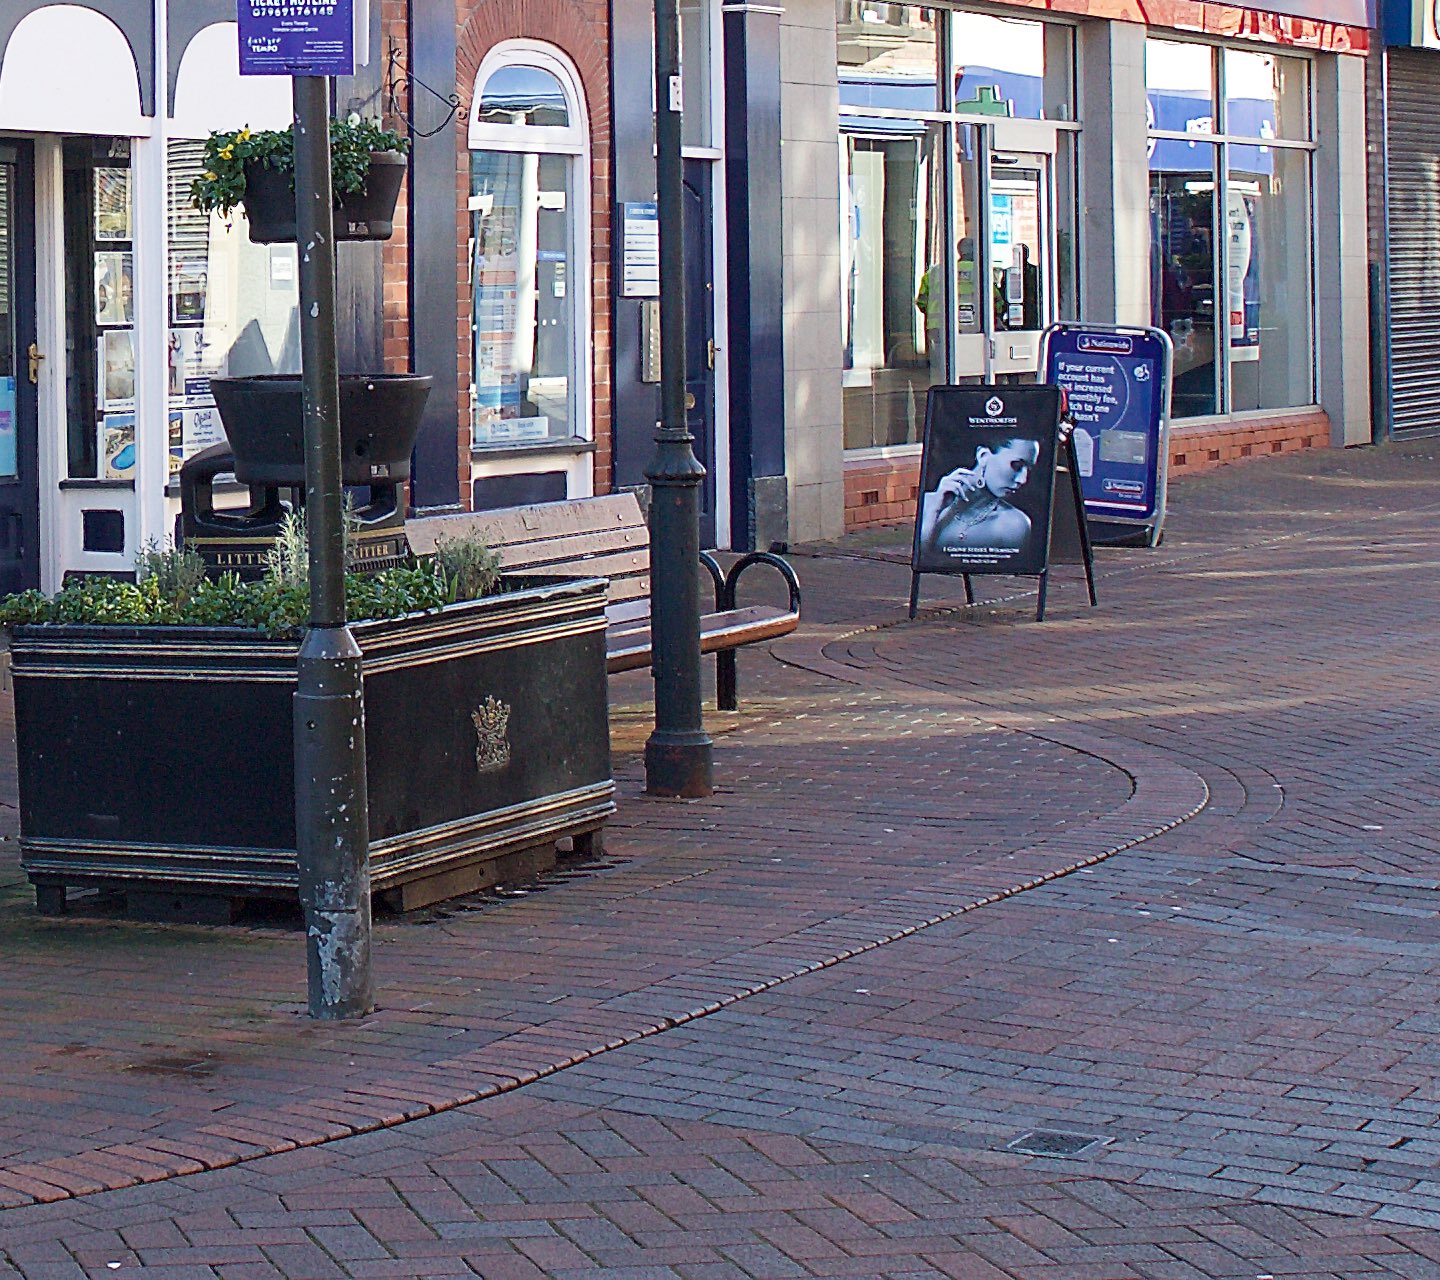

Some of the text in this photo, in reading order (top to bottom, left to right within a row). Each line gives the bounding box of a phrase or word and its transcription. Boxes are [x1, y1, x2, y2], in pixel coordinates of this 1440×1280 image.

[1090, 339, 1130, 349] Nationwide
[1065, 365, 1084, 373] your
[1085, 366, 1115, 374] current
[1058, 374, 1105, 383] account has
[1074, 385, 1113, 393] increased
[1069, 394, 1102, 404] monthly
[1084, 403, 1093, 411] to
[352, 544, 389, 559] LITTER
[216, 552, 270, 565] LITTE
